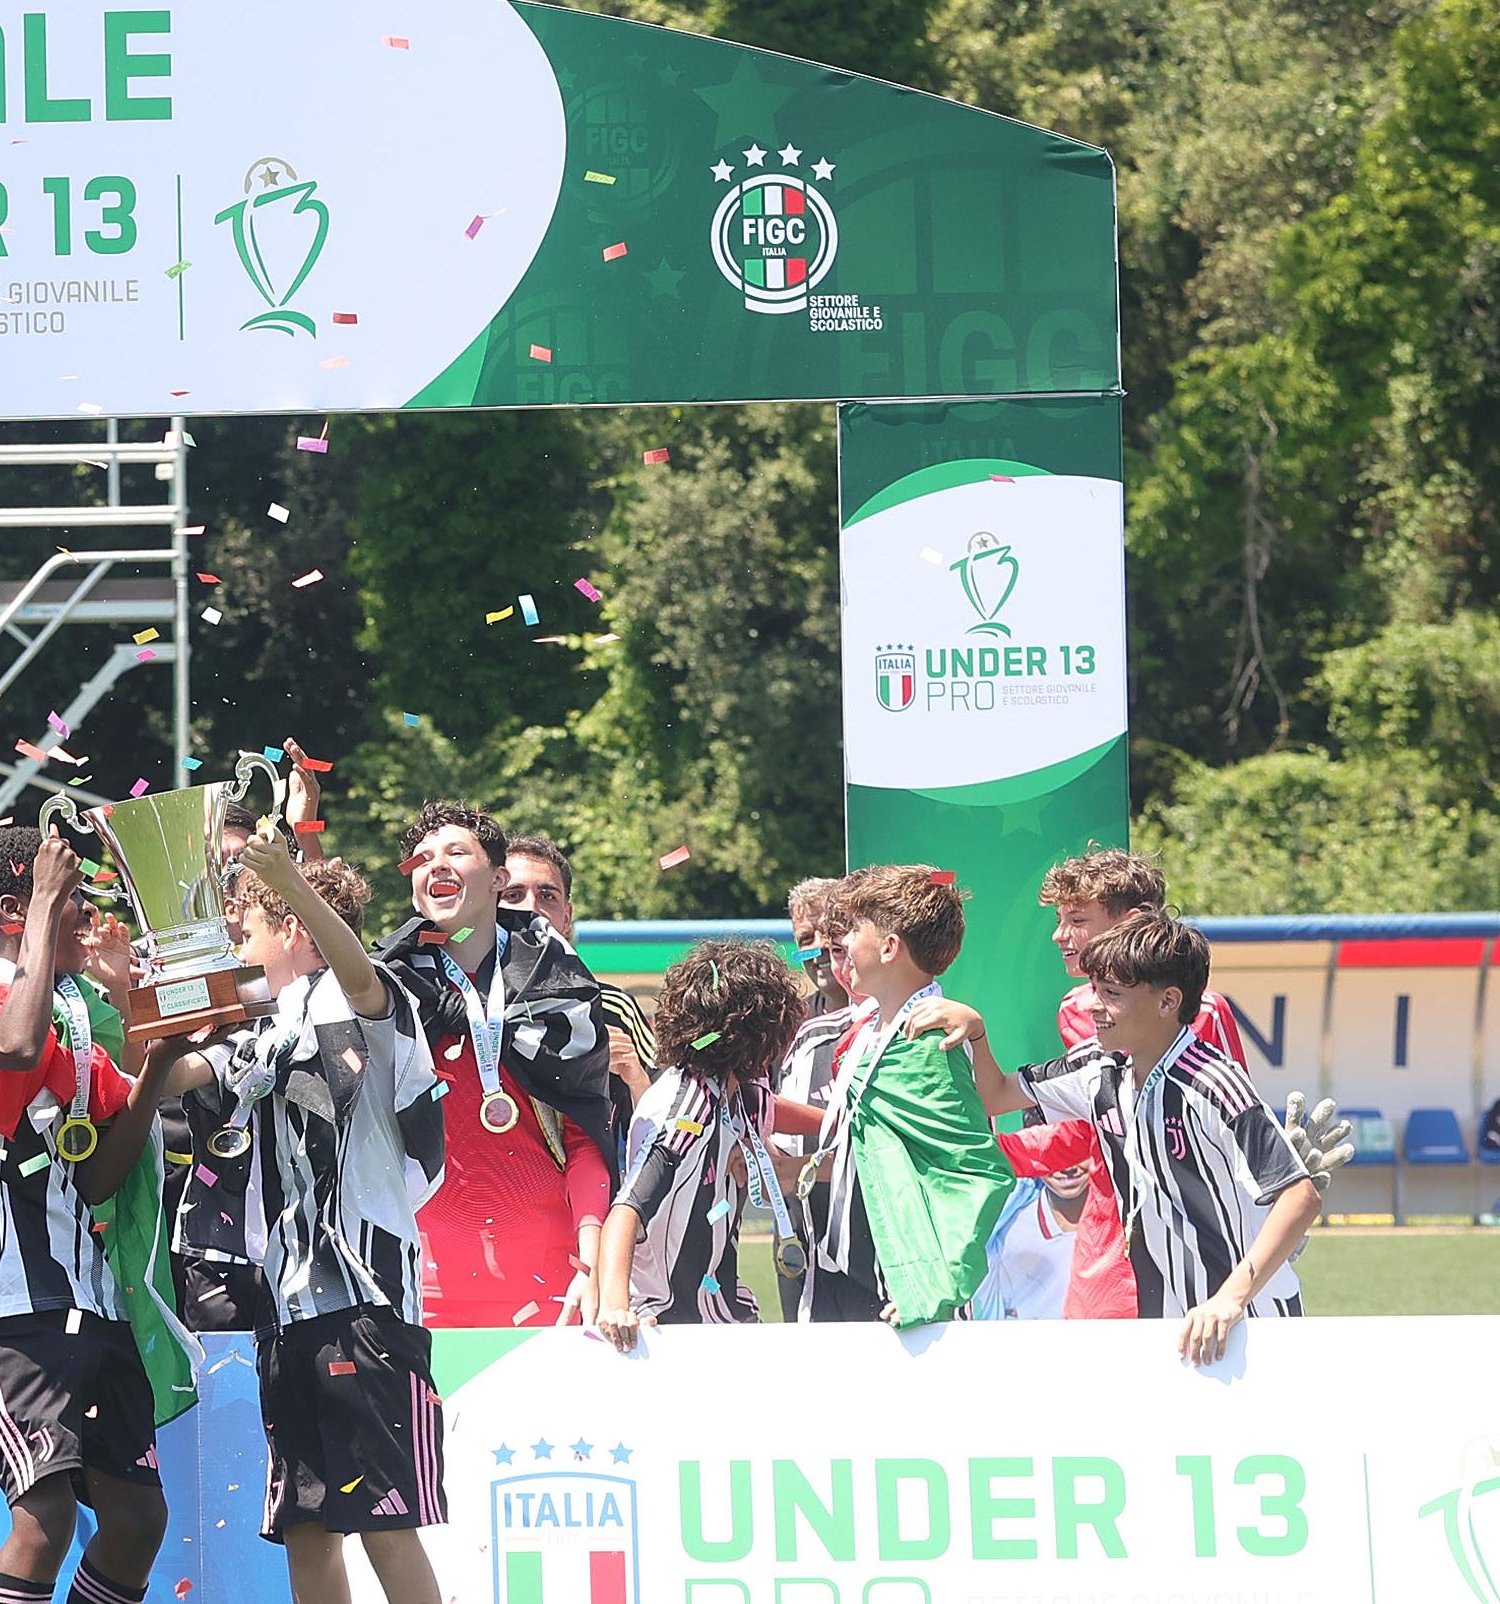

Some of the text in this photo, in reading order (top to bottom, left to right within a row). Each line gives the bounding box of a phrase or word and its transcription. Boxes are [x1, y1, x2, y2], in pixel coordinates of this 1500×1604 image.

[42, 176, 139, 256] 13
[742, 217, 806, 245] FIGC
[762, 247, 787, 256] ITALIA
[8, 280, 140, 304] GIOVANILE
[809, 294, 859, 307] SETTORE
[809, 306, 881, 319] GIOVANILE E
[810, 318, 883, 332] SCOLASTICO
[878, 658, 912, 670] ITALIA
[926, 645, 1096, 679] UNDER 13
[926, 680, 995, 712] PRO
[1002, 682, 1098, 696] SETTORE GIOVANILE
[1011, 695, 1069, 706] SCOLASTICO
[748, 1172, 762, 1206] NALE
[504, 1492, 624, 1527] ITALIA
[678, 1454, 1309, 1562] UNDER 13
